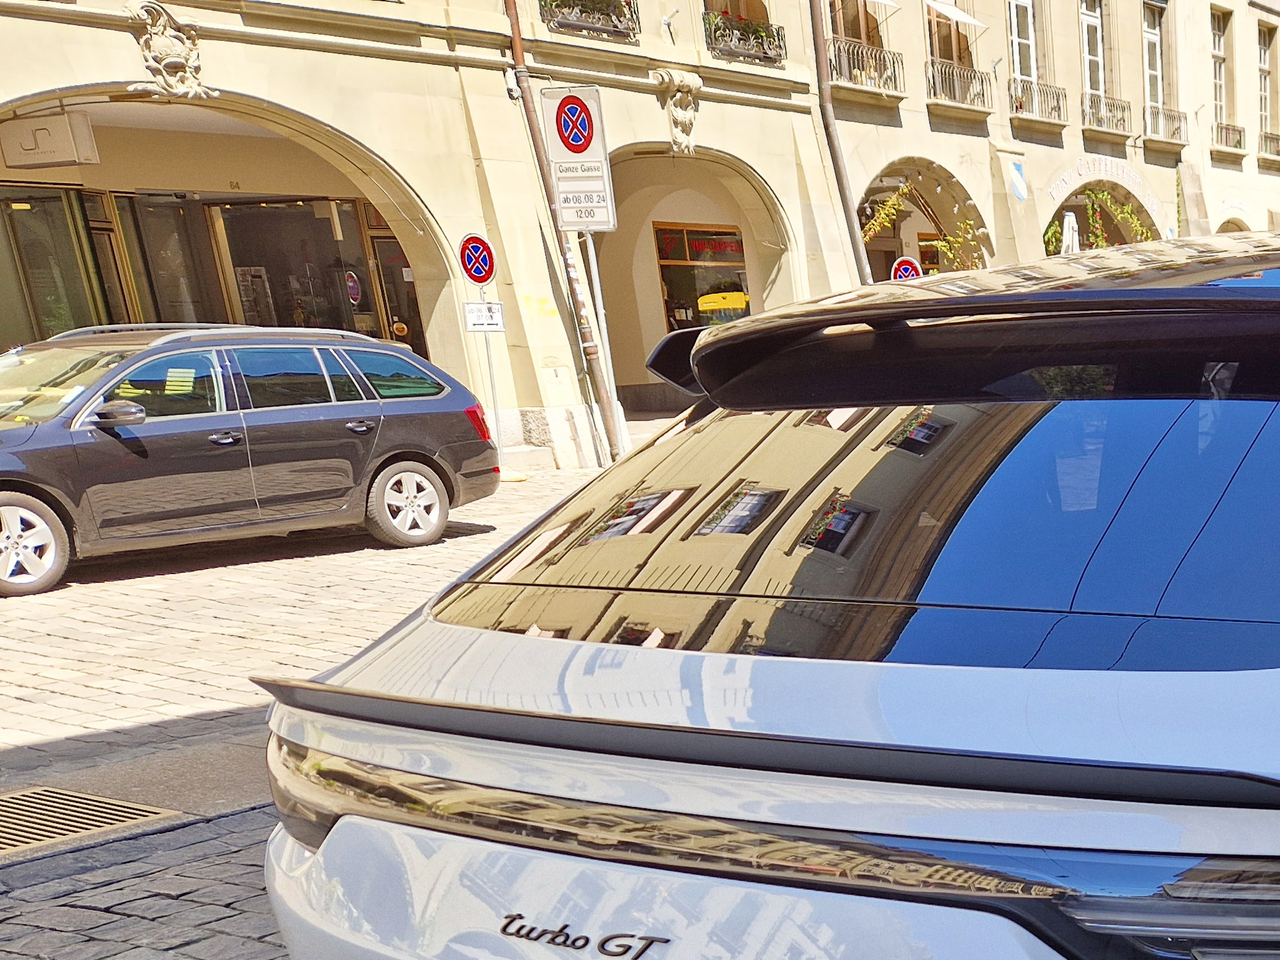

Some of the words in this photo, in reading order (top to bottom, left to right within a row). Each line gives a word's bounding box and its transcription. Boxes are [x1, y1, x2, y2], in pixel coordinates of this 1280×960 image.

[558, 164, 579, 174] Ganze
[580, 163, 601, 173] Gasse
[562, 194, 572, 204] ab
[500, 913, 590, 950] turbo
[597, 933, 672, 960] GT
